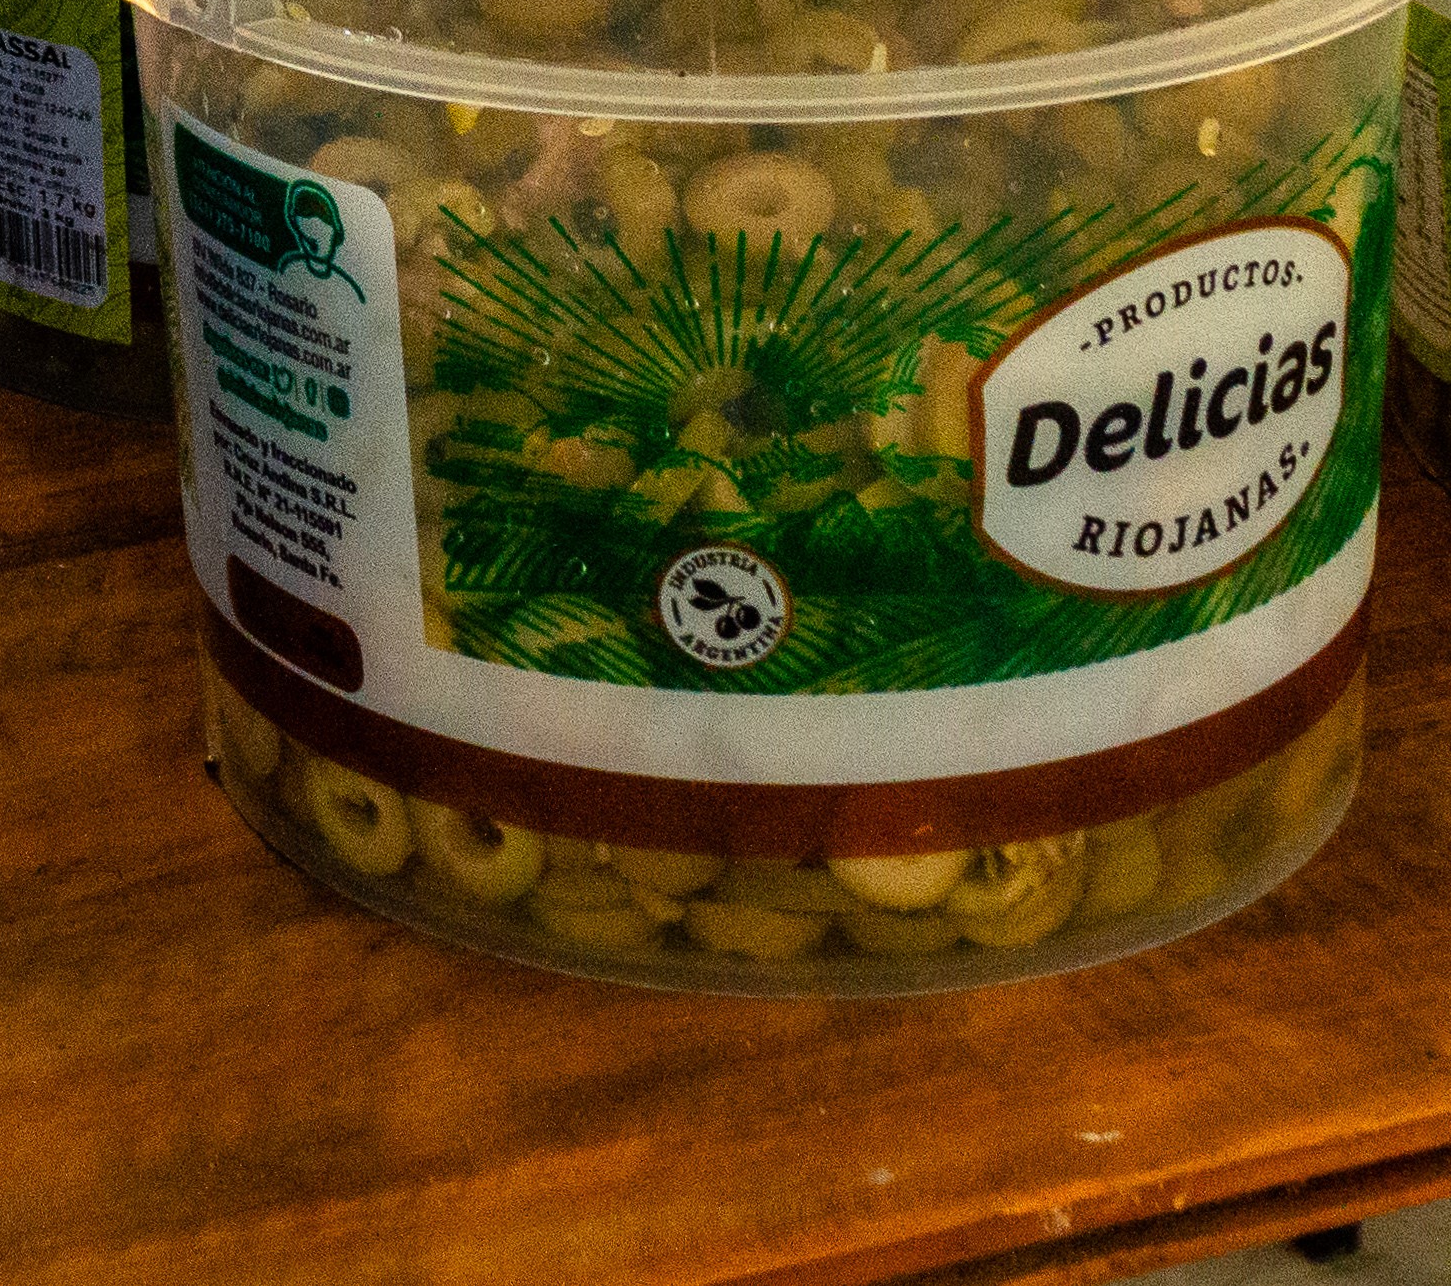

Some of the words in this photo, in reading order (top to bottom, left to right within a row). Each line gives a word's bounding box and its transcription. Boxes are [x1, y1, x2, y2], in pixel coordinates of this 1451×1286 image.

[72, 198, 96, 218] kg
[1093, 257, 1297, 350] PRODUCTOS
[1006, 320, 1338, 489] Delicias
[1071, 449, 1303, 561] RIOJANAS
[669, 552, 758, 590] INDUSTRIA
[679, 616, 783, 661] ARGENTINA
